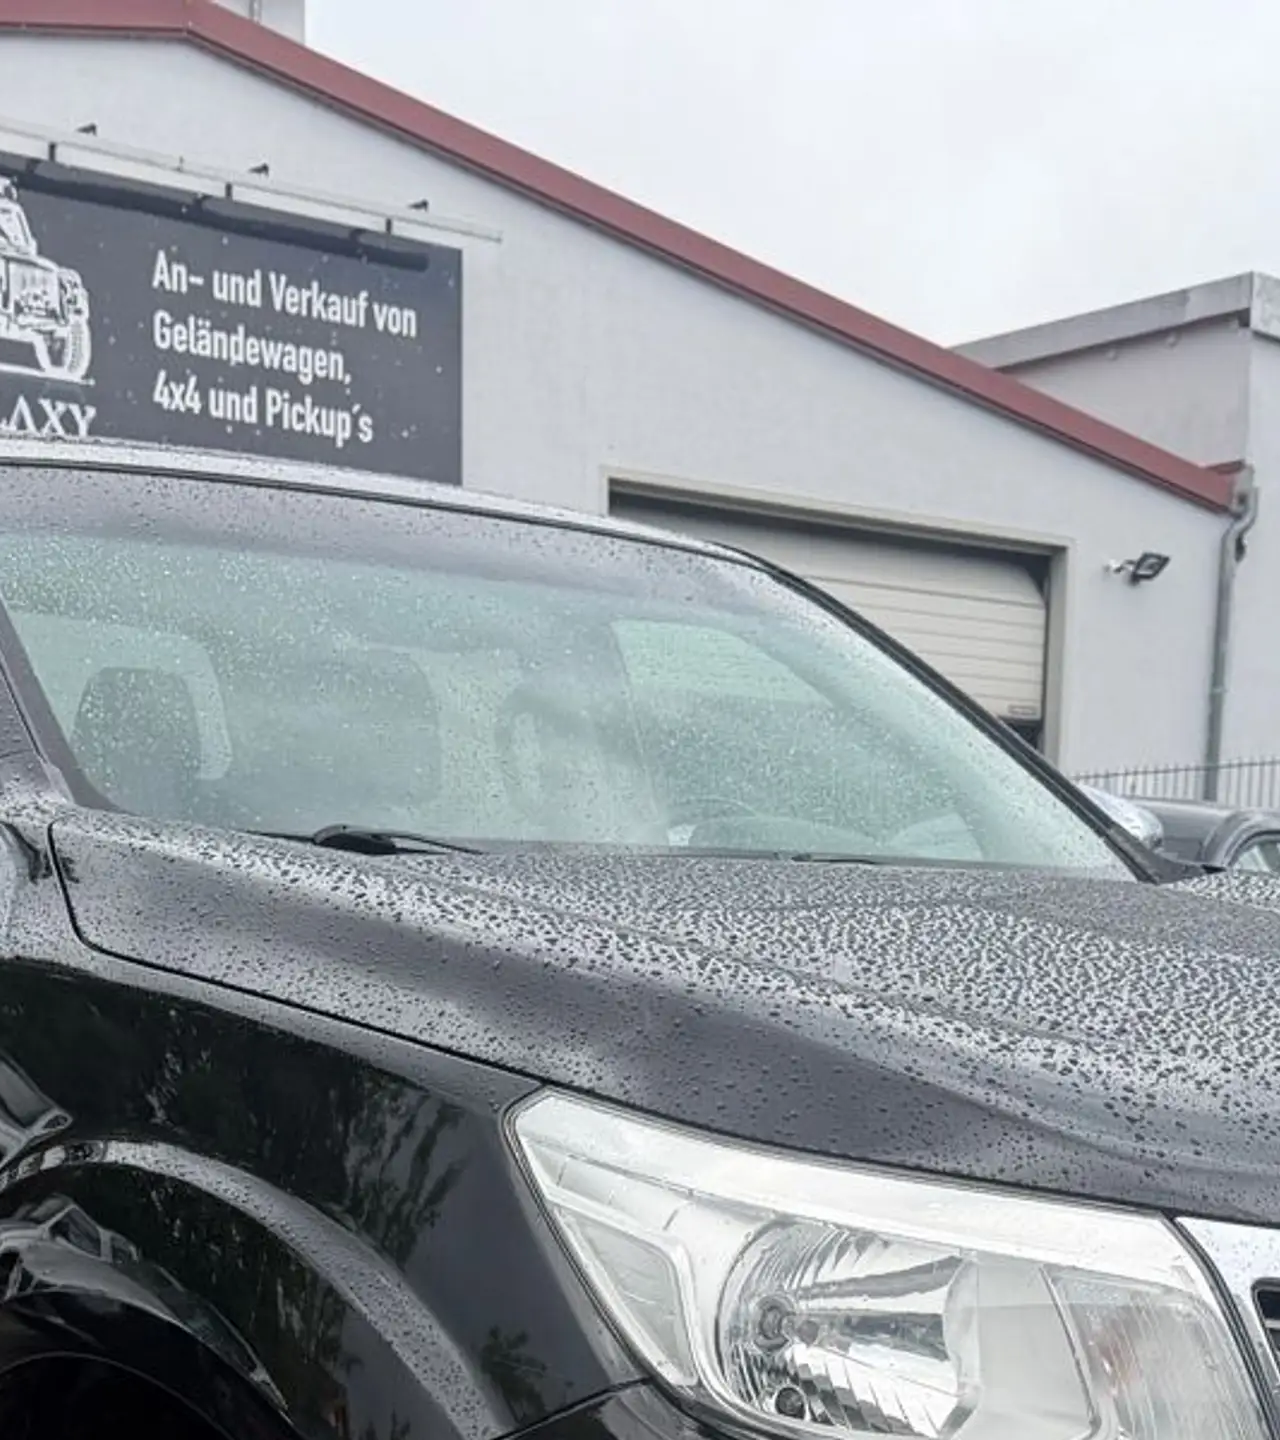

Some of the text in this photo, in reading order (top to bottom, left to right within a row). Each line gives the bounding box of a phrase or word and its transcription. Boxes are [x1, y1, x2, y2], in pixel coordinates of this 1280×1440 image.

[152, 250, 418, 338] An- und Verkauf von
[153, 309, 351, 385] Geländewagen,
[153, 369, 202, 414] 4x4
[209, 386, 258, 424] und
